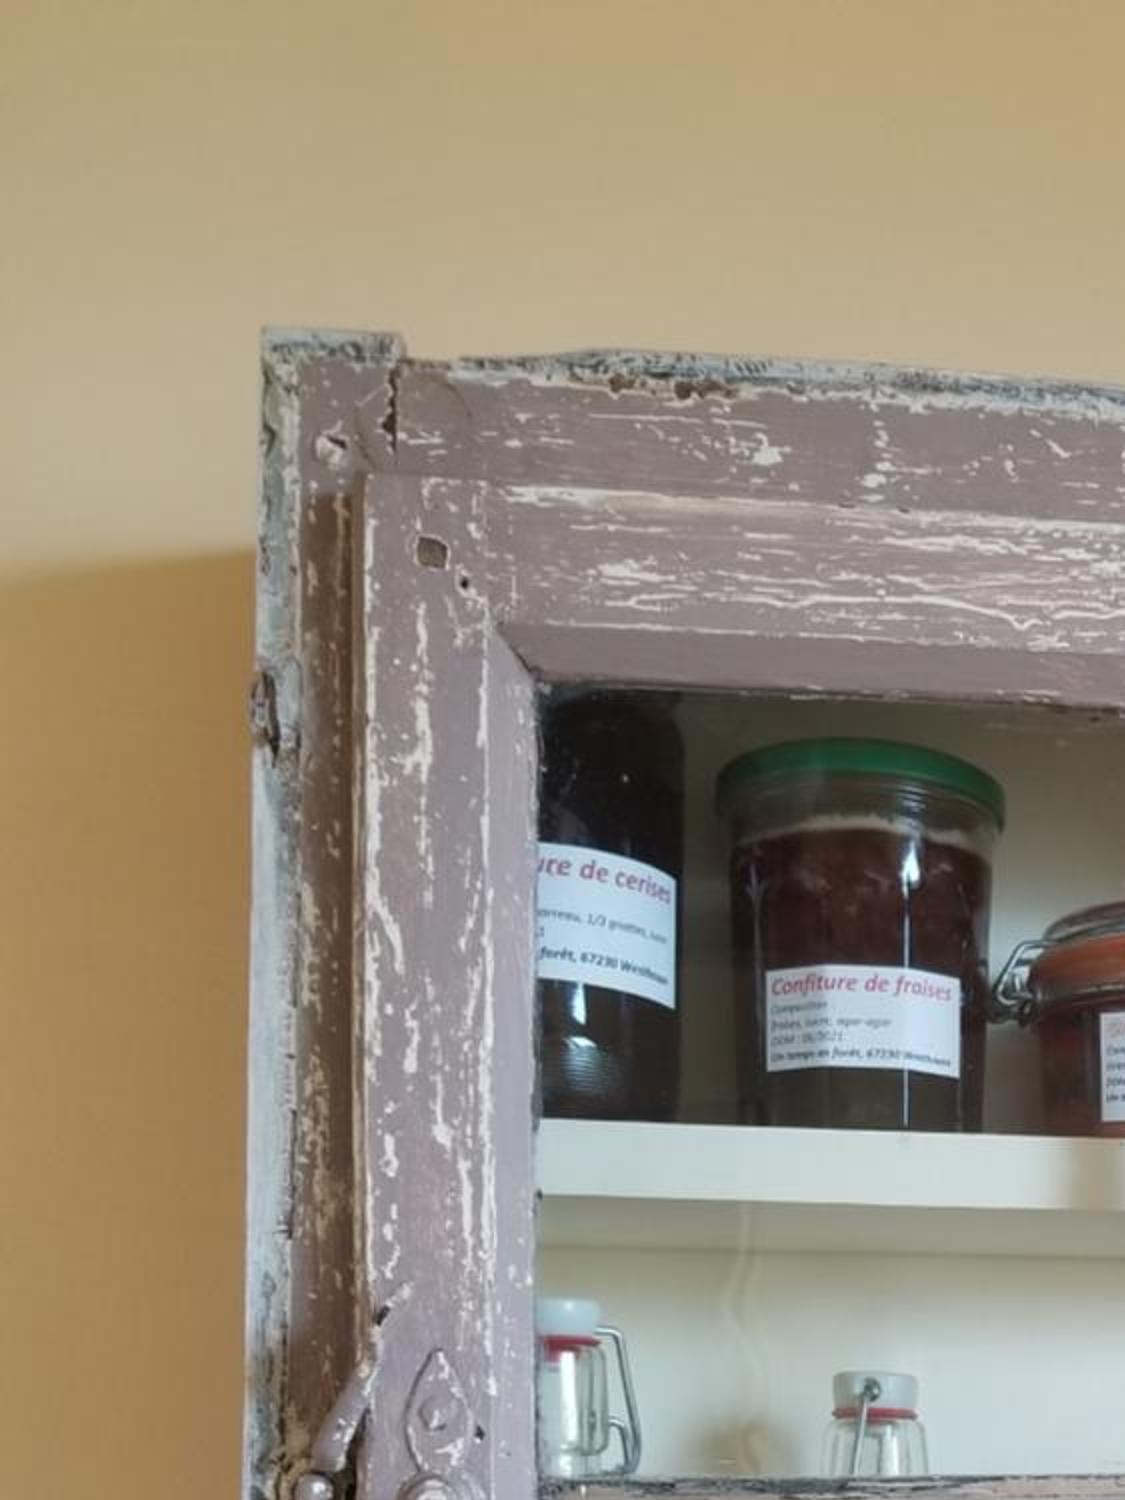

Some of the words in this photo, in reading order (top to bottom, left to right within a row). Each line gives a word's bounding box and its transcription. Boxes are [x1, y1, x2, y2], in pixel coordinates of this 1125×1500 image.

[579, 859, 609, 883] de
[615, 872, 671, 904] cerises
[771, 973, 859, 998] Confiture
[864, 974, 889, 993] de
[894, 975, 953, 1003] fraises
